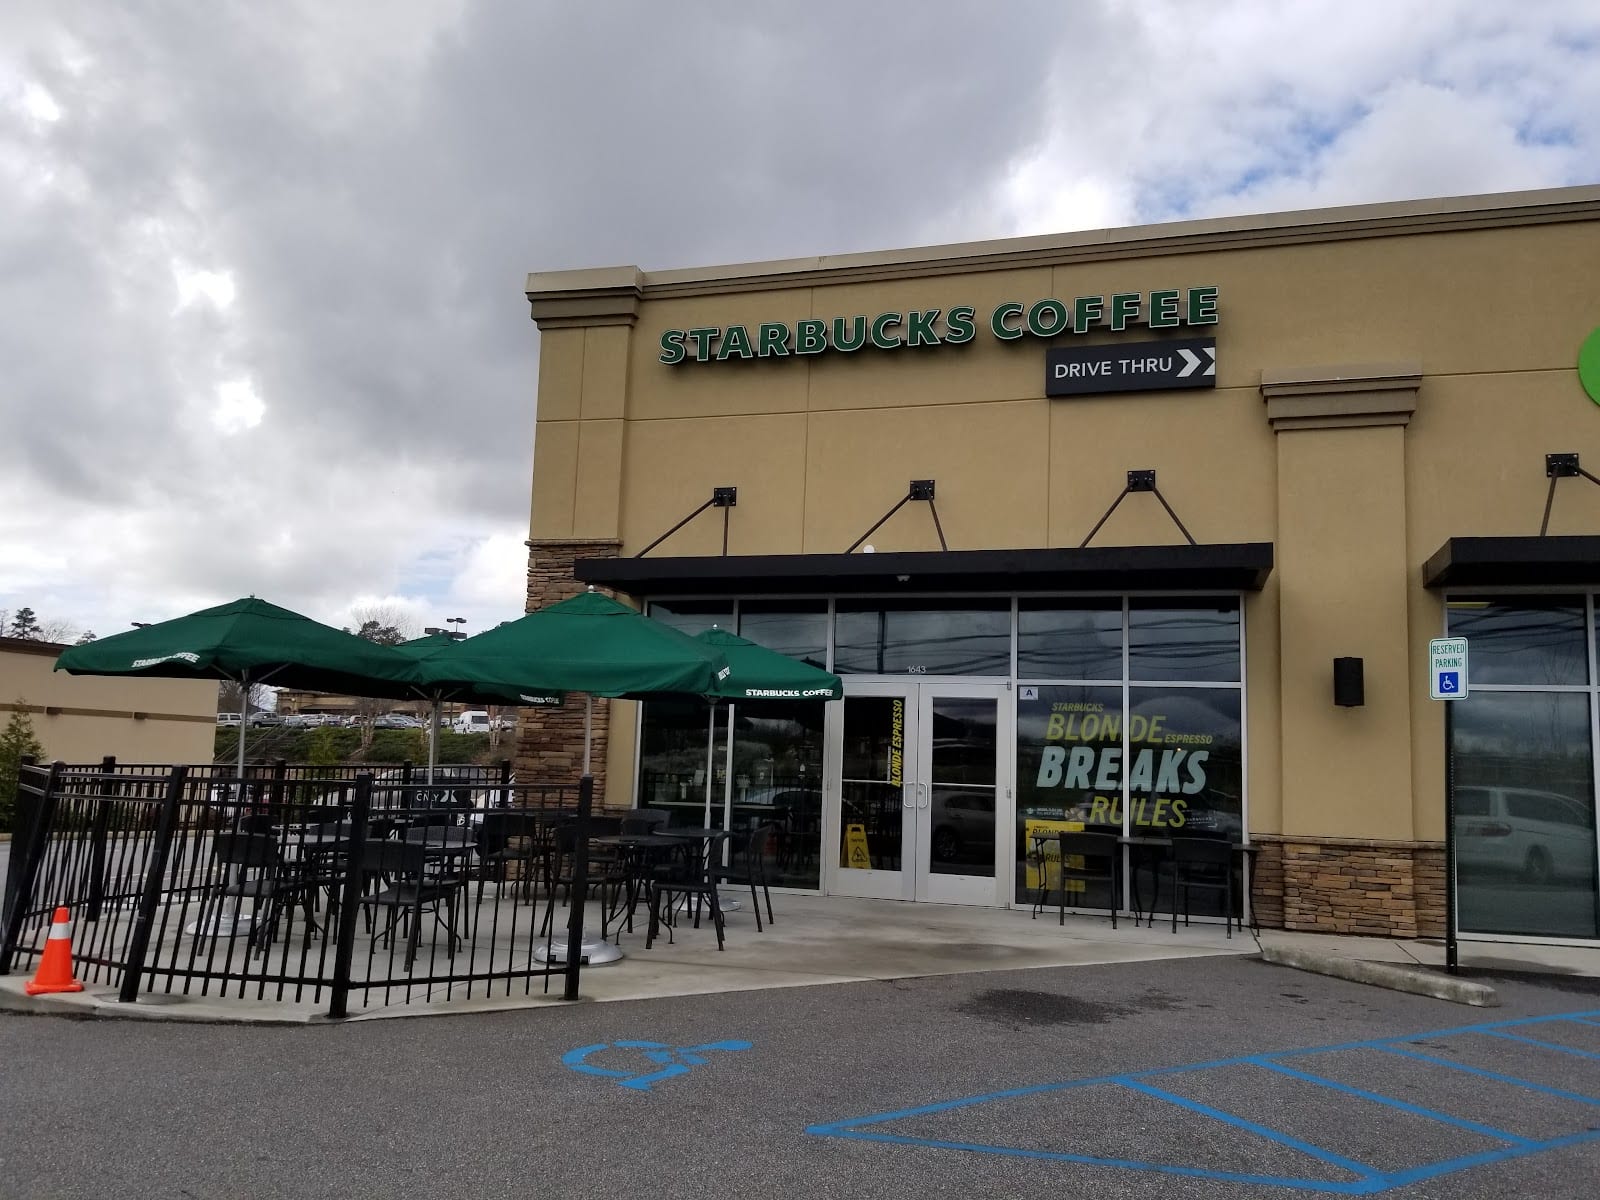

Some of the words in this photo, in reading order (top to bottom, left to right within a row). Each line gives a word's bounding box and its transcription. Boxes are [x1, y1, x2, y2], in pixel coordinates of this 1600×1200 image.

[658, 307, 976, 365] STARBUCKS
[990, 286, 1219, 339] COFFEE
[1055, 358, 1112, 379] DRIVE
[1118, 355, 1173, 375] THRU
[1432, 644, 1465, 654] RESERVED
[906, 665, 927, 674] 1643
[1435, 658, 1463, 668] PARKING
[745, 688, 800, 697] STARBUCKS
[802, 688, 834, 697] COFFEE
[1025, 689, 1033, 697] A
[1051, 702, 1104, 712] STARBUCKS
[892, 699, 903, 749] ESPRESSO
[1045, 714, 1167, 743] BLONDE
[1164, 734, 1213, 745] ESPRESSO
[1036, 746, 1210, 794] BREAKS
[1089, 796, 1188, 828] RULES
